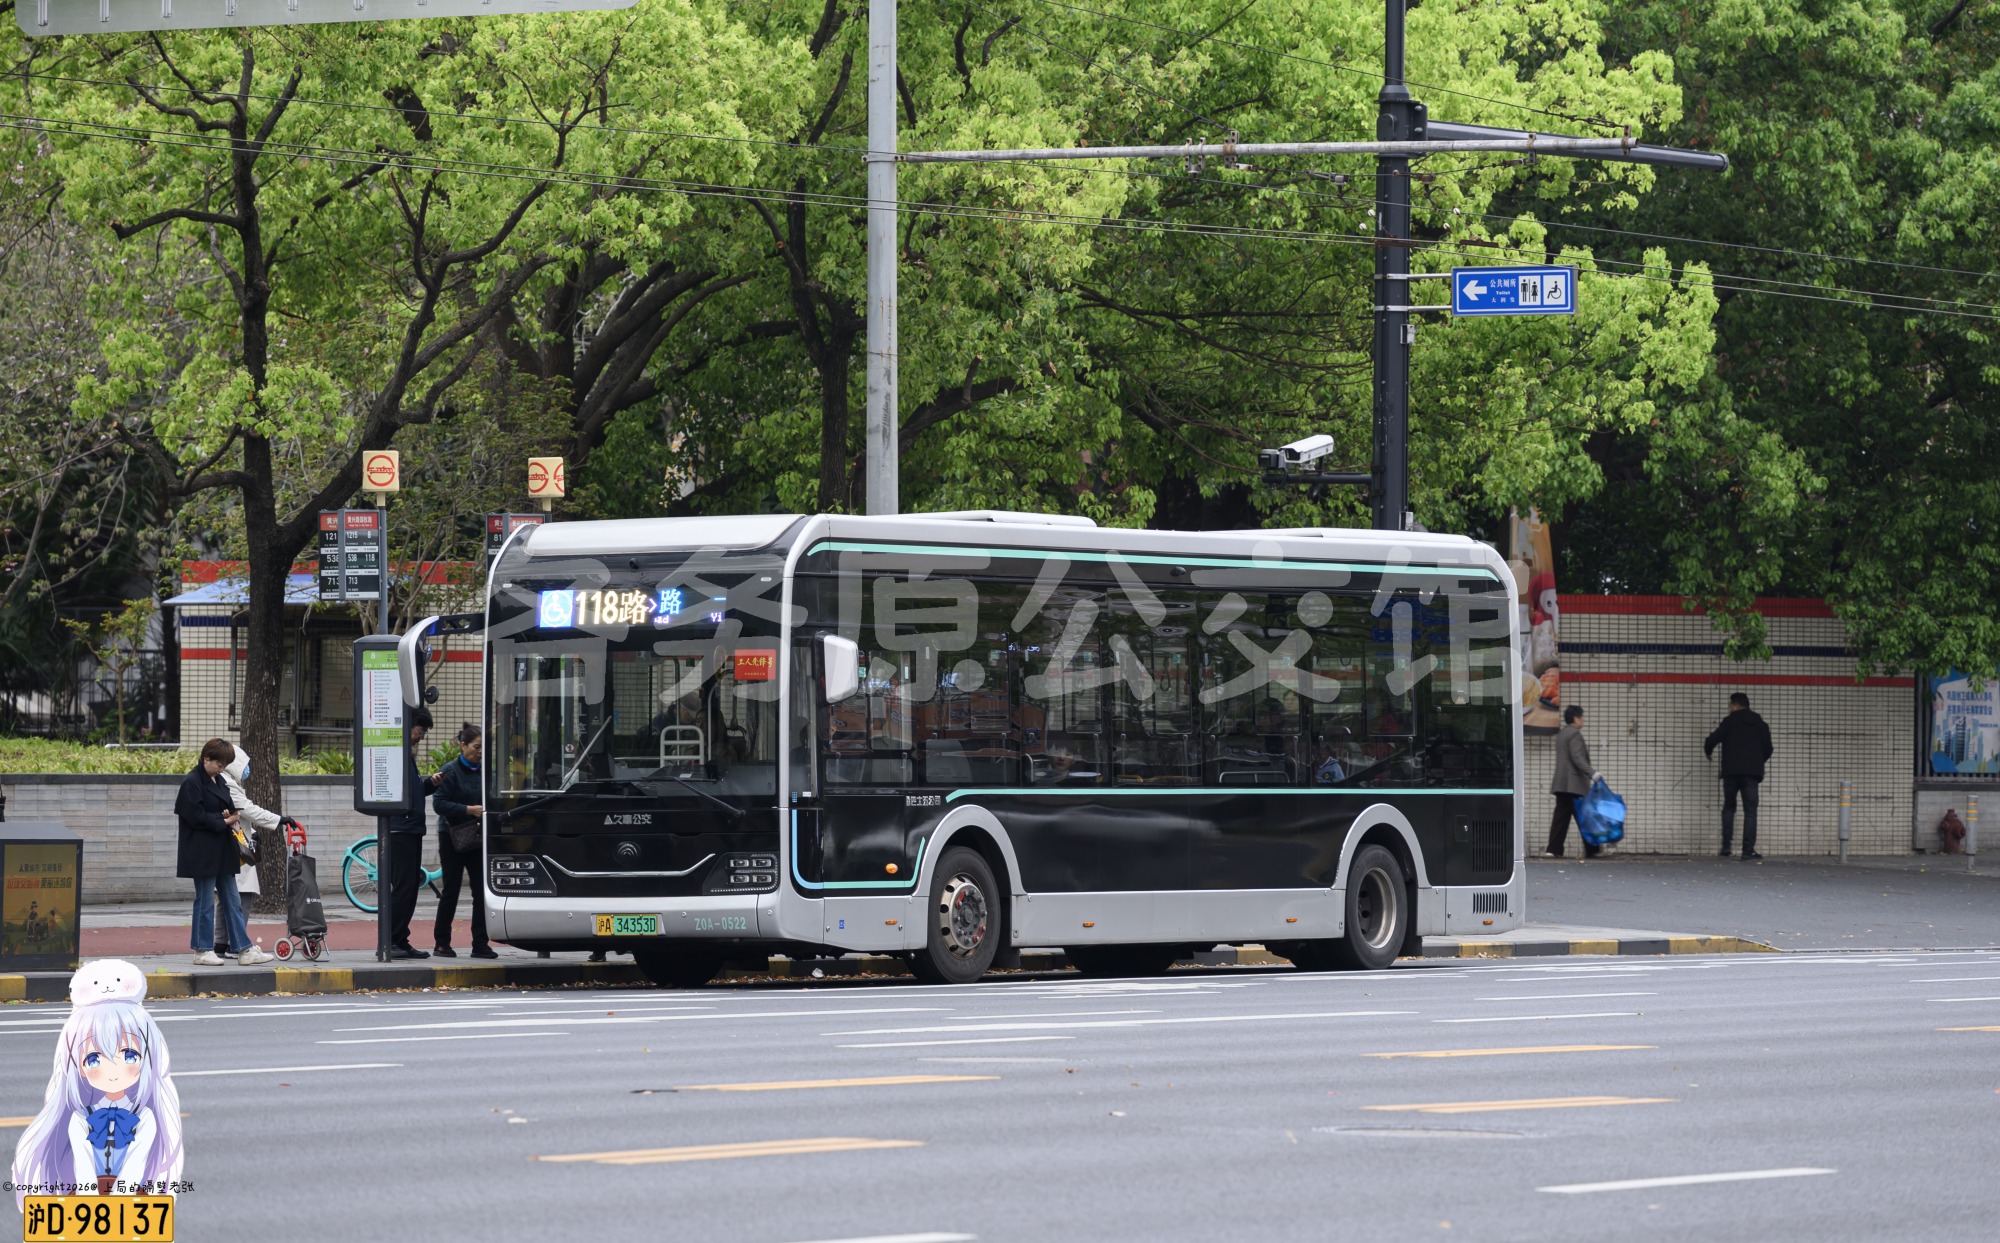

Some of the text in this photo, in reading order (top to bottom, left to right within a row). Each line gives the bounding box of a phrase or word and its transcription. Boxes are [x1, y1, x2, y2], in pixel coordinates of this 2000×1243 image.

[347, 553, 358, 562] 538
[348, 576, 358, 585] 713
[575, 589, 648, 625] 118路
[737, 656, 774, 668] 工人先锋号
